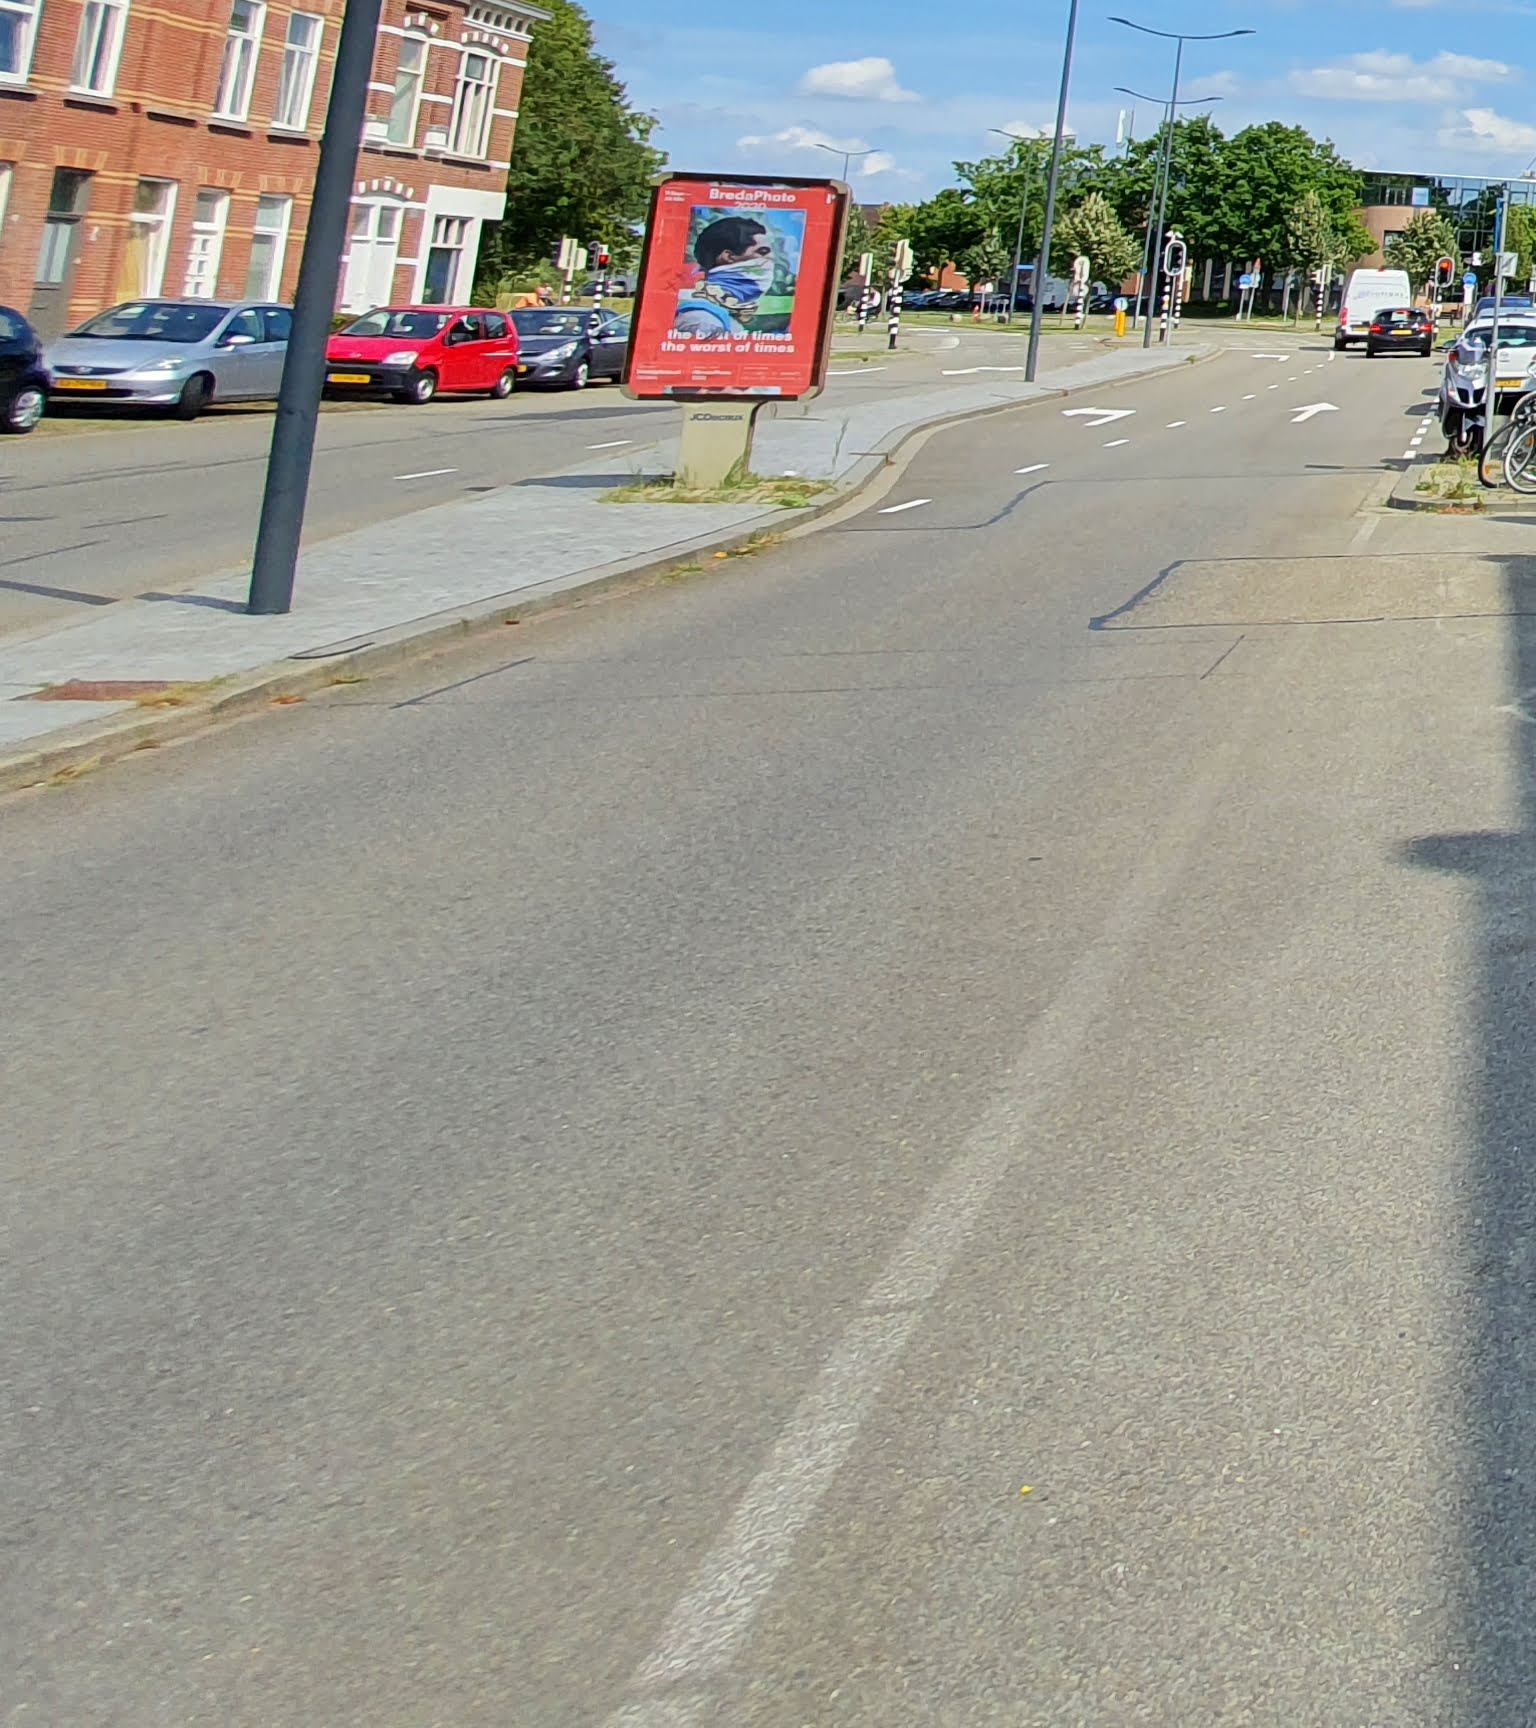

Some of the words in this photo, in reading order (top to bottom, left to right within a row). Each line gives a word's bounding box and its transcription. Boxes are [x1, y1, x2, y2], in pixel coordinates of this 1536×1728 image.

[709, 188, 796, 203] BredaPhoto
[667, 329, 692, 341] the
[733, 330, 750, 341] of
[751, 330, 793, 342] times
[660, 341, 687, 352] the
[689, 342, 733, 352] worst
[735, 342, 751, 353] of
[753, 342, 795, 353] times
